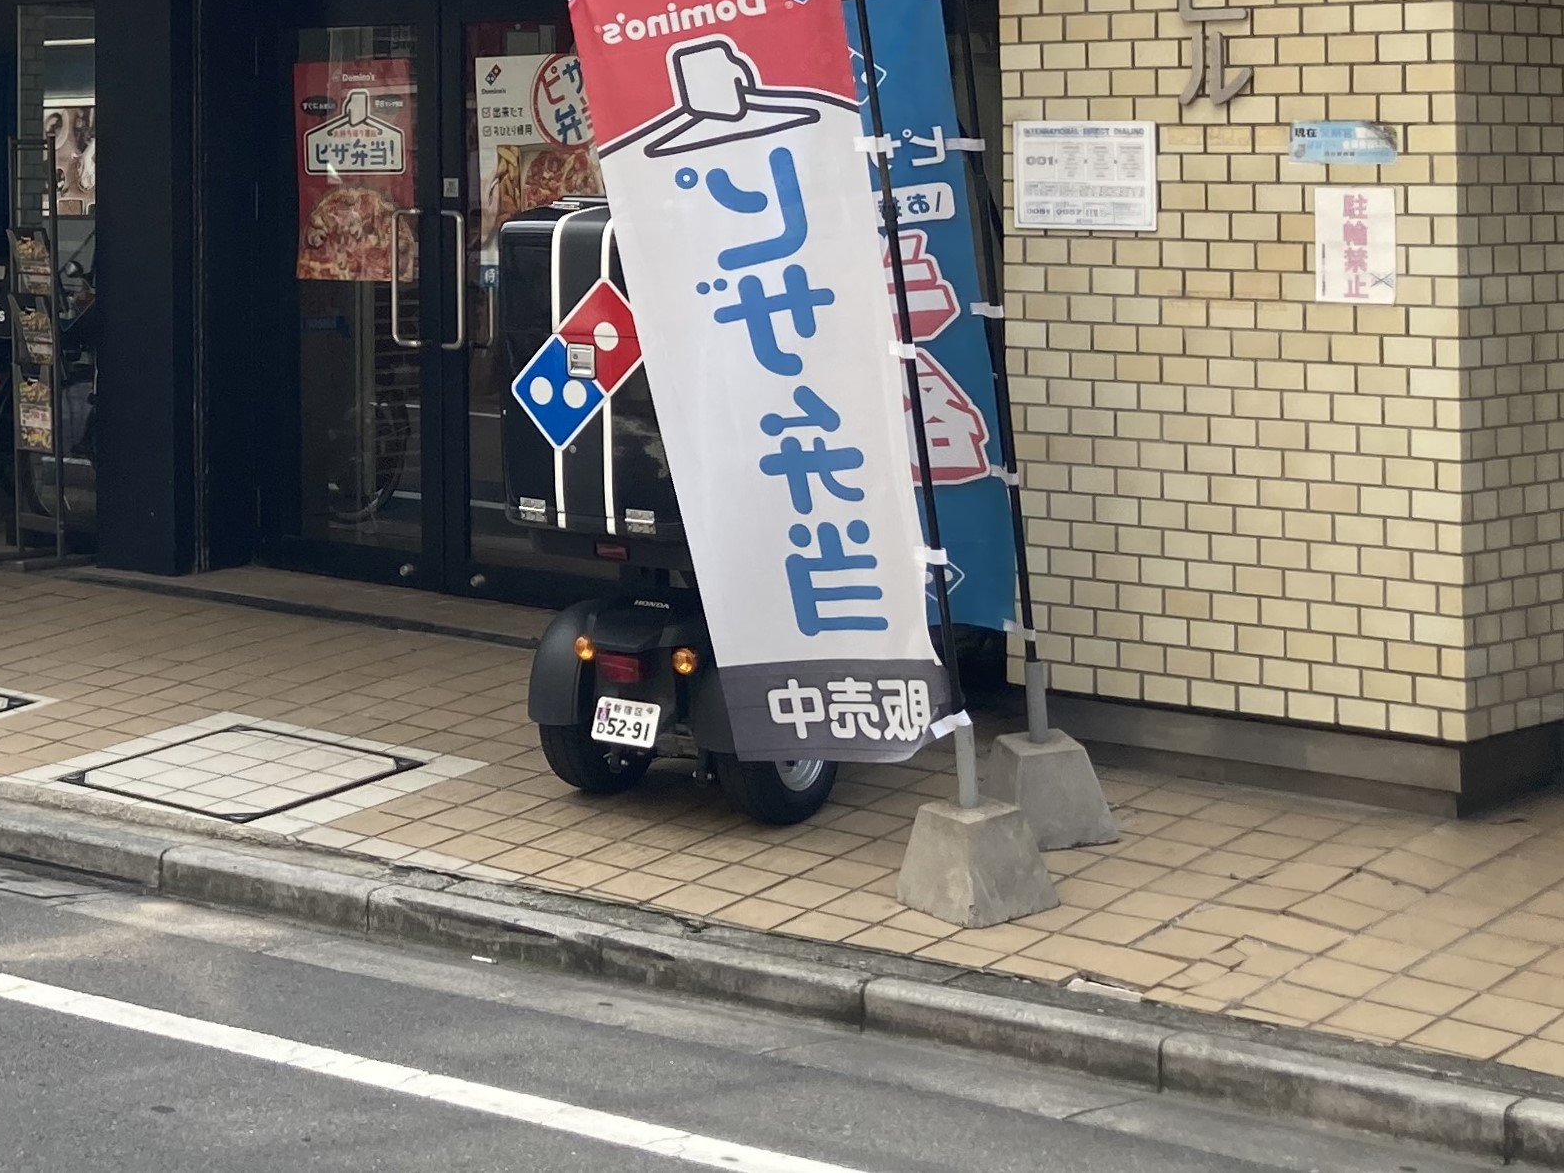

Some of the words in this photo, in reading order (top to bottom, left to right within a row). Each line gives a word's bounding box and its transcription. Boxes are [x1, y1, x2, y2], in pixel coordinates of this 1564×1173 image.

[1342, 193, 1370, 300] 駐輪禁止
[634, 599, 670, 609] HONDA
[606, 717, 650, 742] 52-91
